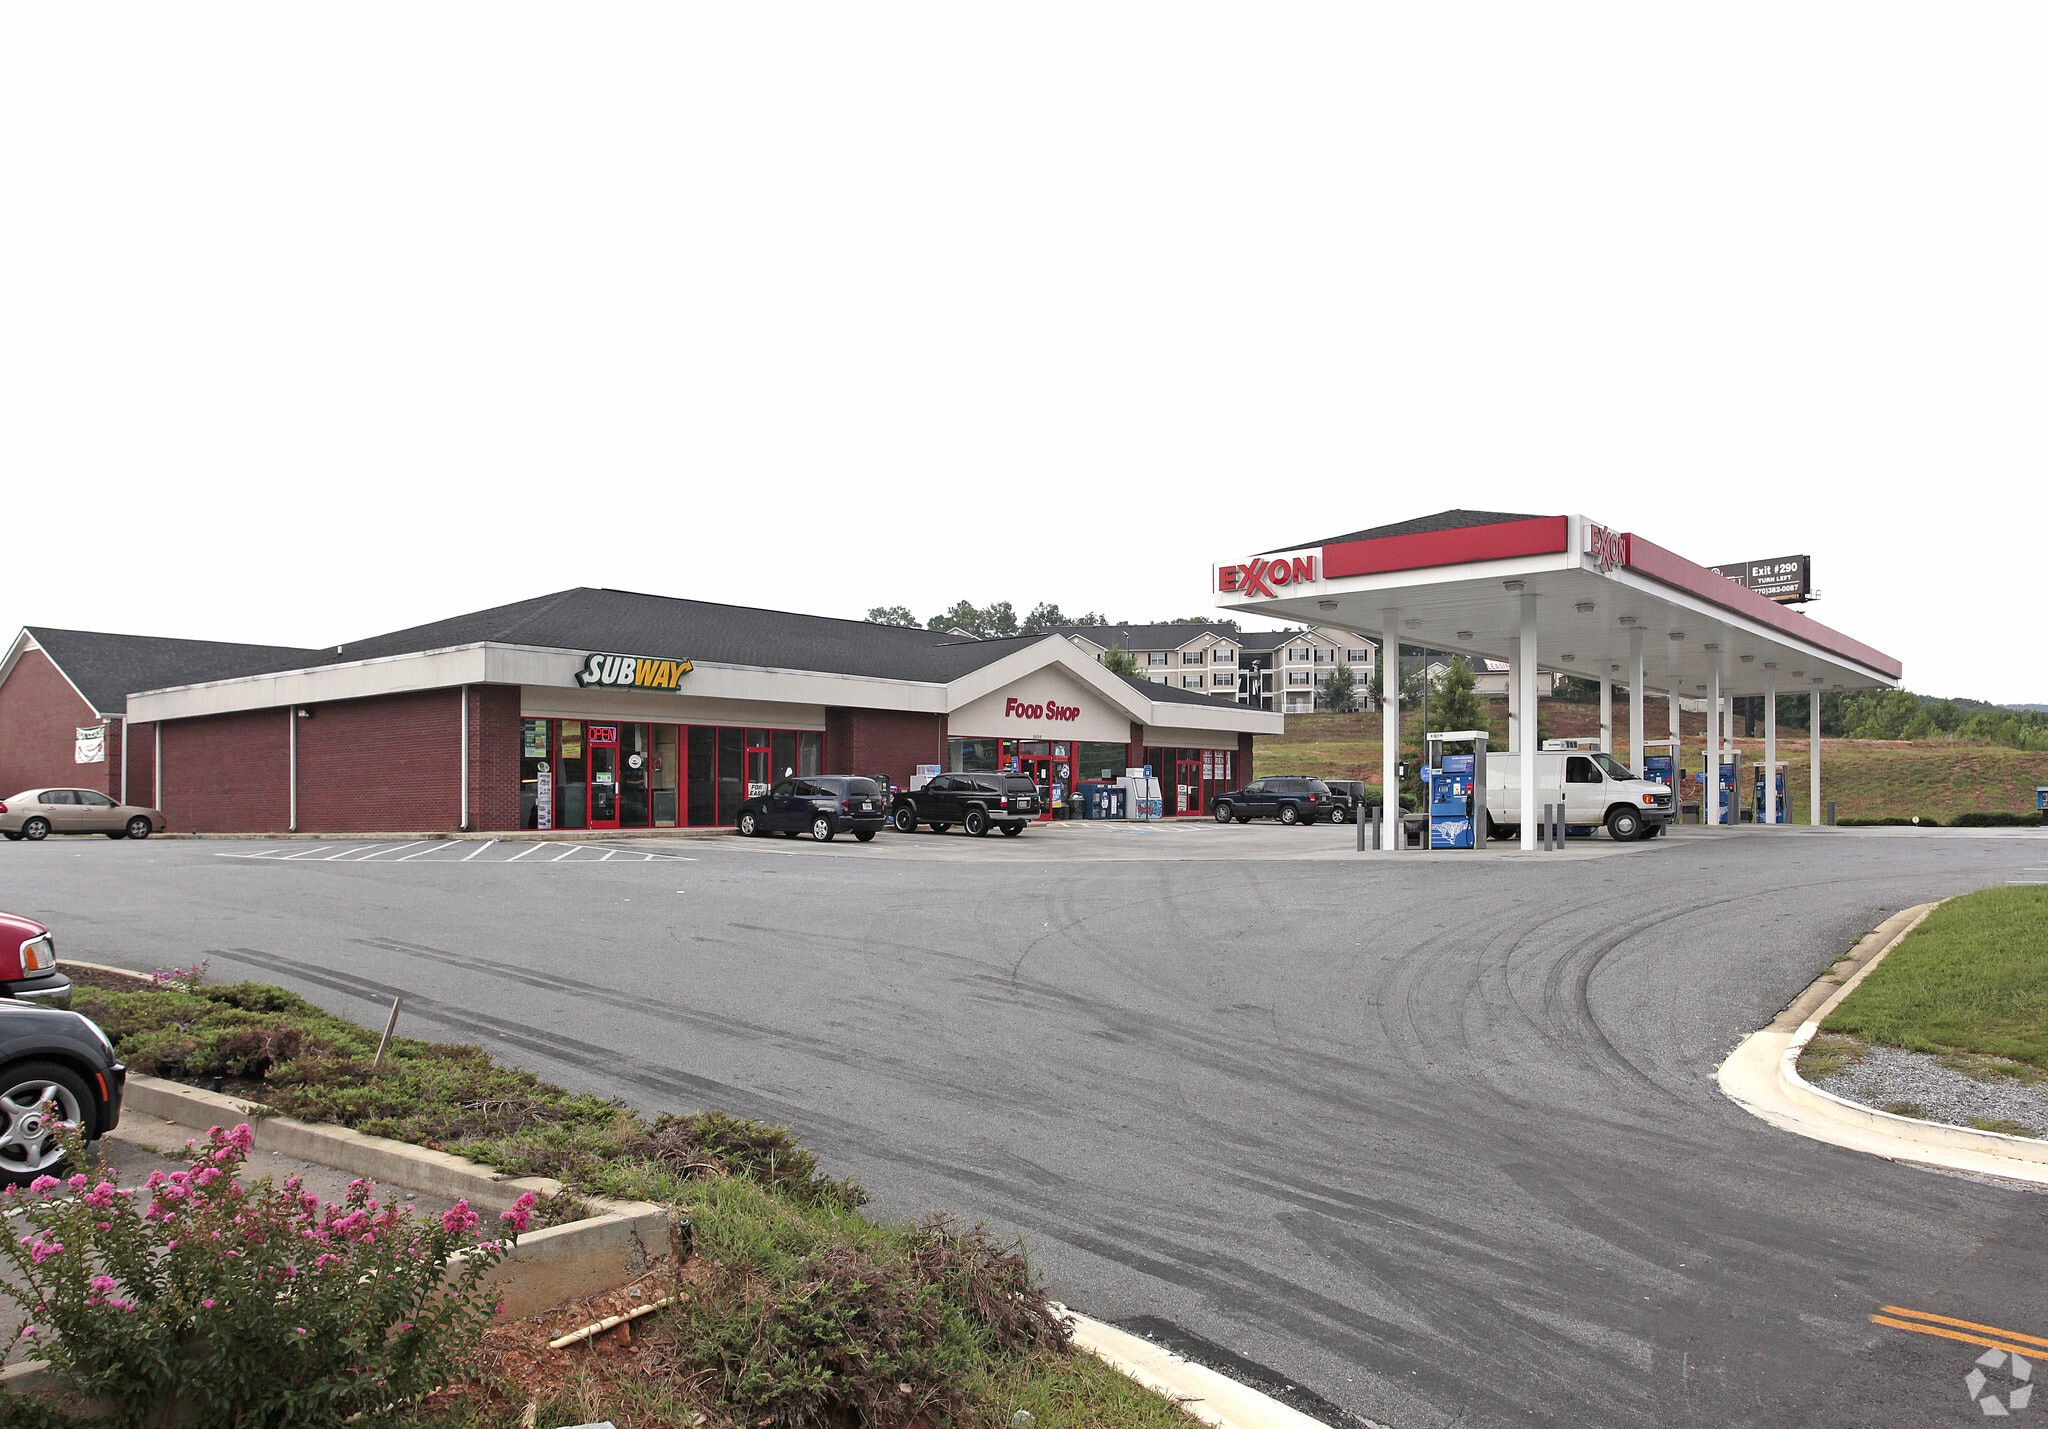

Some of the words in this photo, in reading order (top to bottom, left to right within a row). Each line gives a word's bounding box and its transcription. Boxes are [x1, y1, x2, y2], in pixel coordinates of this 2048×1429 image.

[1591, 524, 1626, 572] EXXON
[1218, 556, 1314, 597] EXXON
[1752, 565, 1771, 577] Exit
[1774, 562, 1798, 574] #290
[1757, 576, 1775, 584] TURN
[1776, 574, 1792, 582] LEFT
[1752, 584, 1799, 595] 770)382-0087
[581, 654, 693, 688] SUBWAY
[1005, 697, 1044, 719] FOOD
[1045, 700, 1081, 721] SHOP
[589, 727, 616, 741] OPEN
